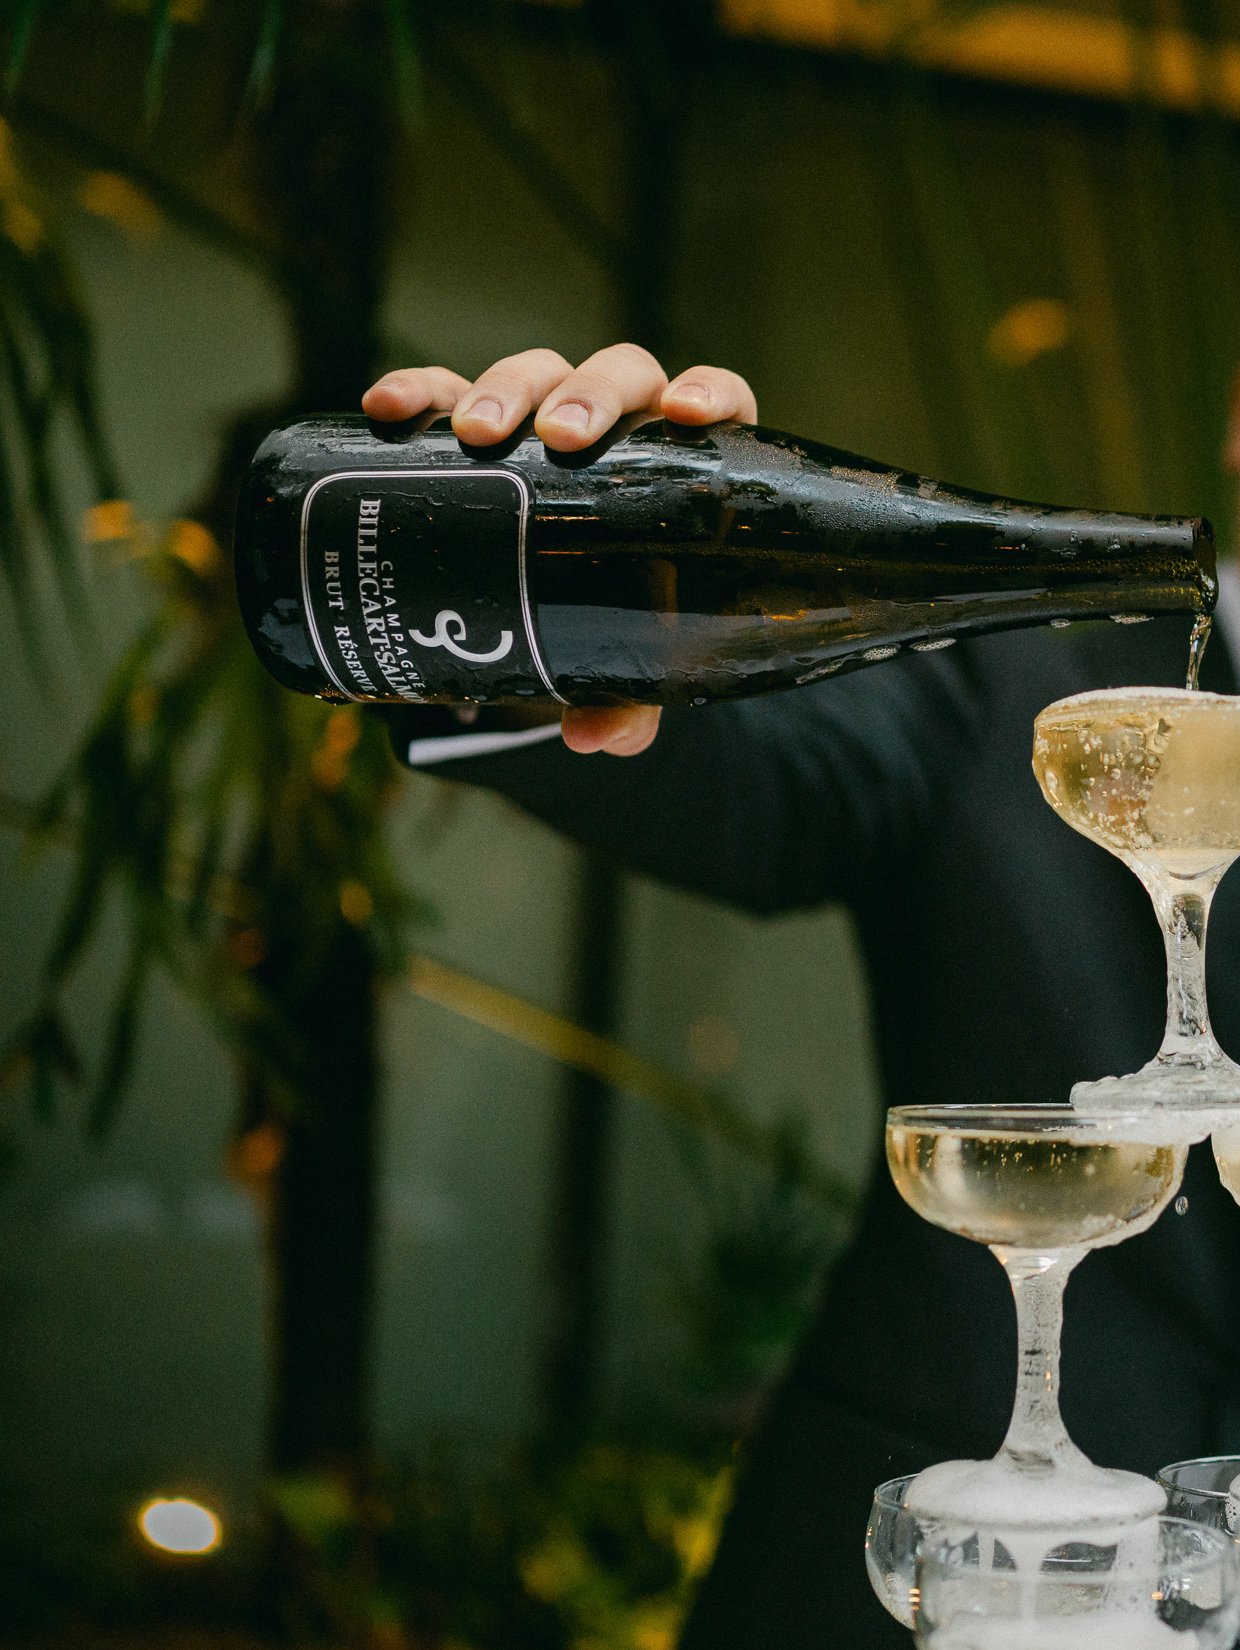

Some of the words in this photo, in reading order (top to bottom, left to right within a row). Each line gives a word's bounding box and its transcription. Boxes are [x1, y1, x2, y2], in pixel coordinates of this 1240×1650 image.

[324, 550, 344, 611] BRUT
[334, 625, 378, 693] RÉSERVE
[357, 498, 427, 704] BILLECART-SALMO
[380, 560, 426, 689] CHAMPAGNE
